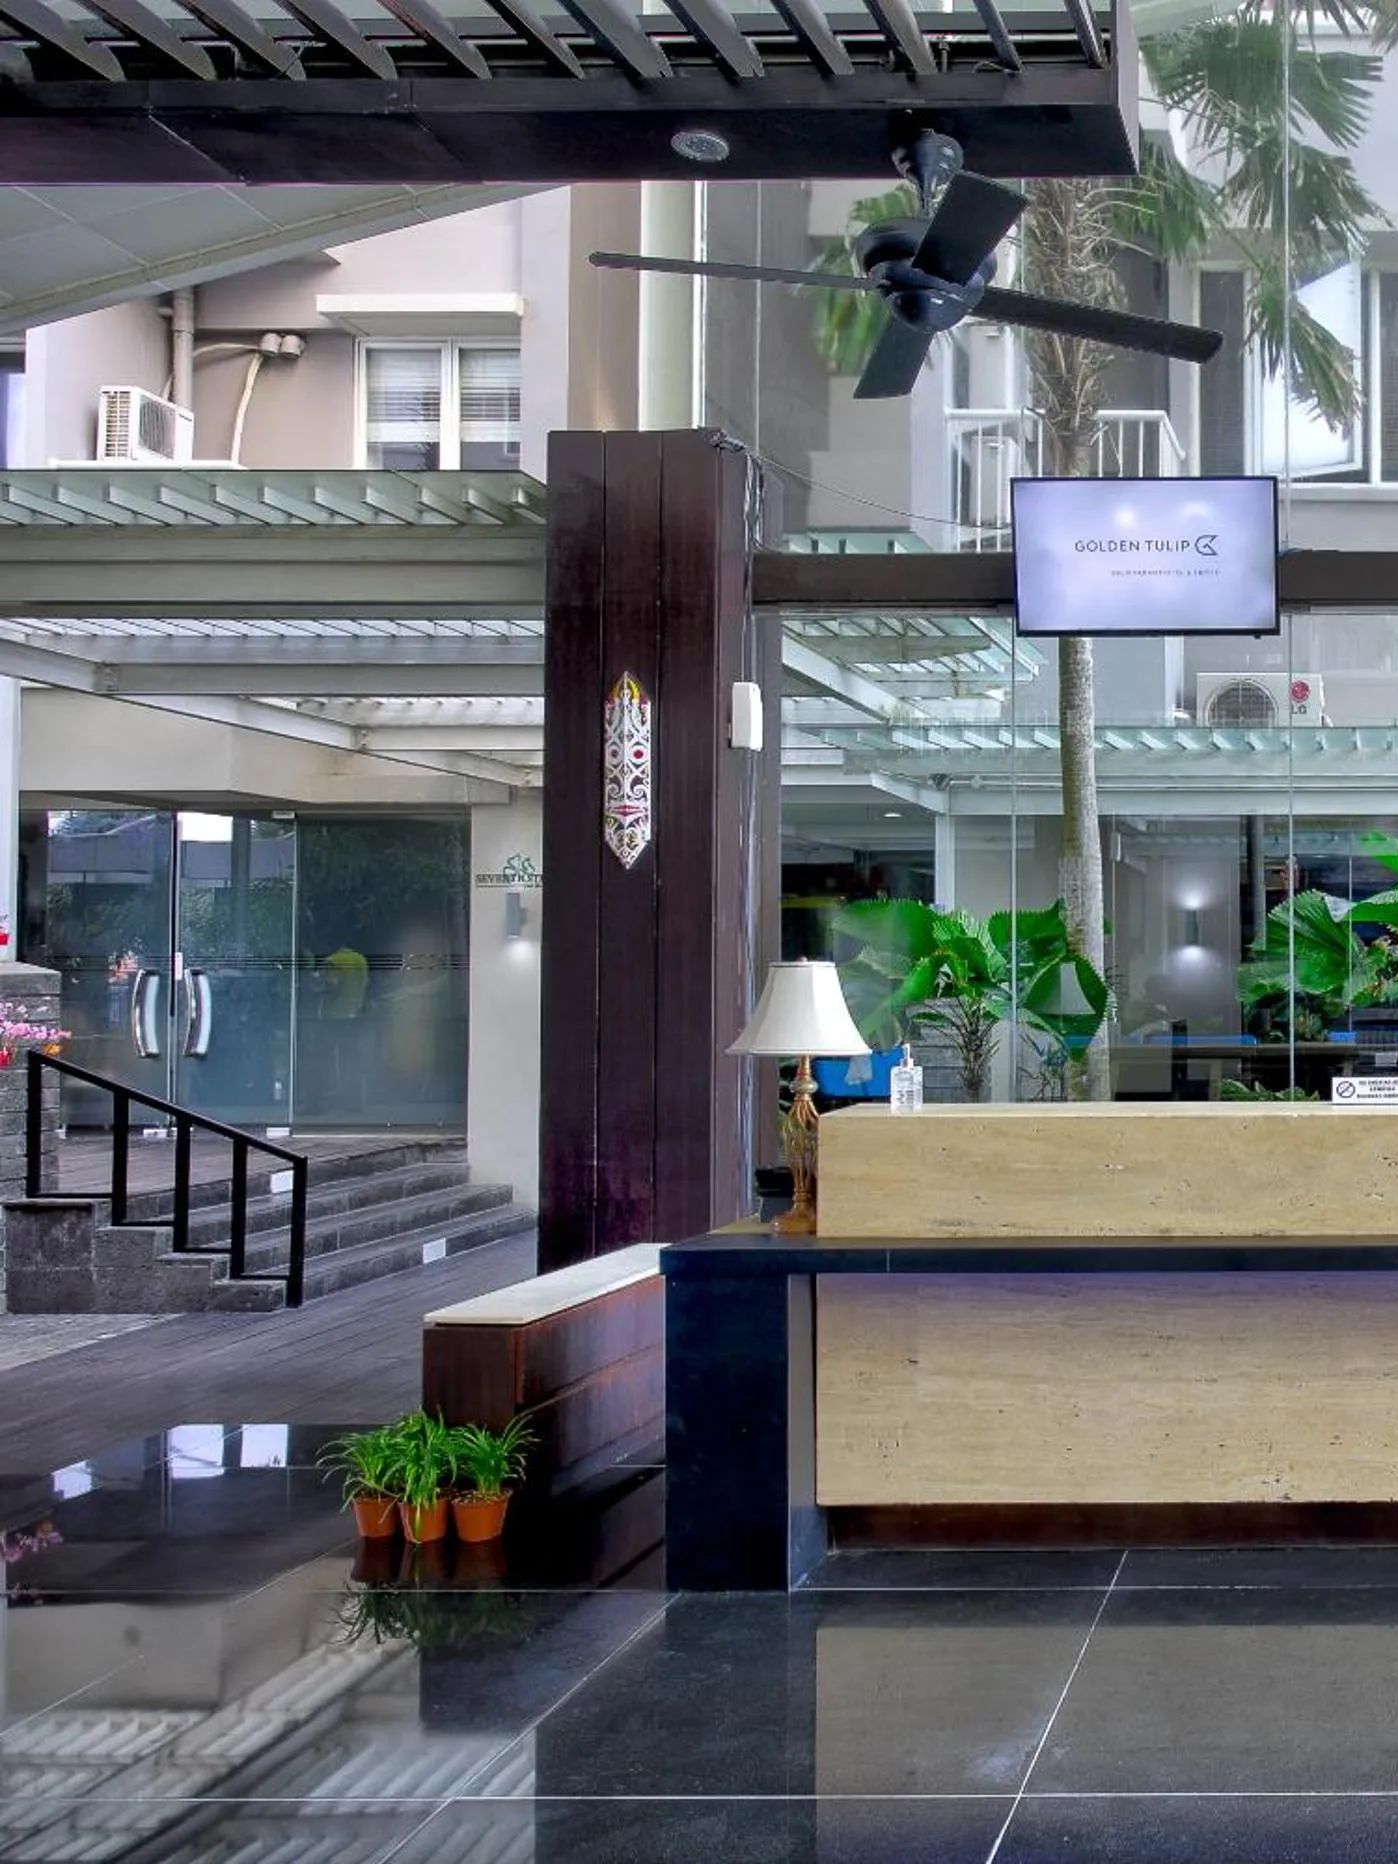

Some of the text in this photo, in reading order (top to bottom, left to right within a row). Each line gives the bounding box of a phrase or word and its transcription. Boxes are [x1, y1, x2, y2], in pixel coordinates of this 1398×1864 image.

[1074, 539, 1190, 553] GOLDEN TULIP
[1290, 704, 1307, 715] LG
